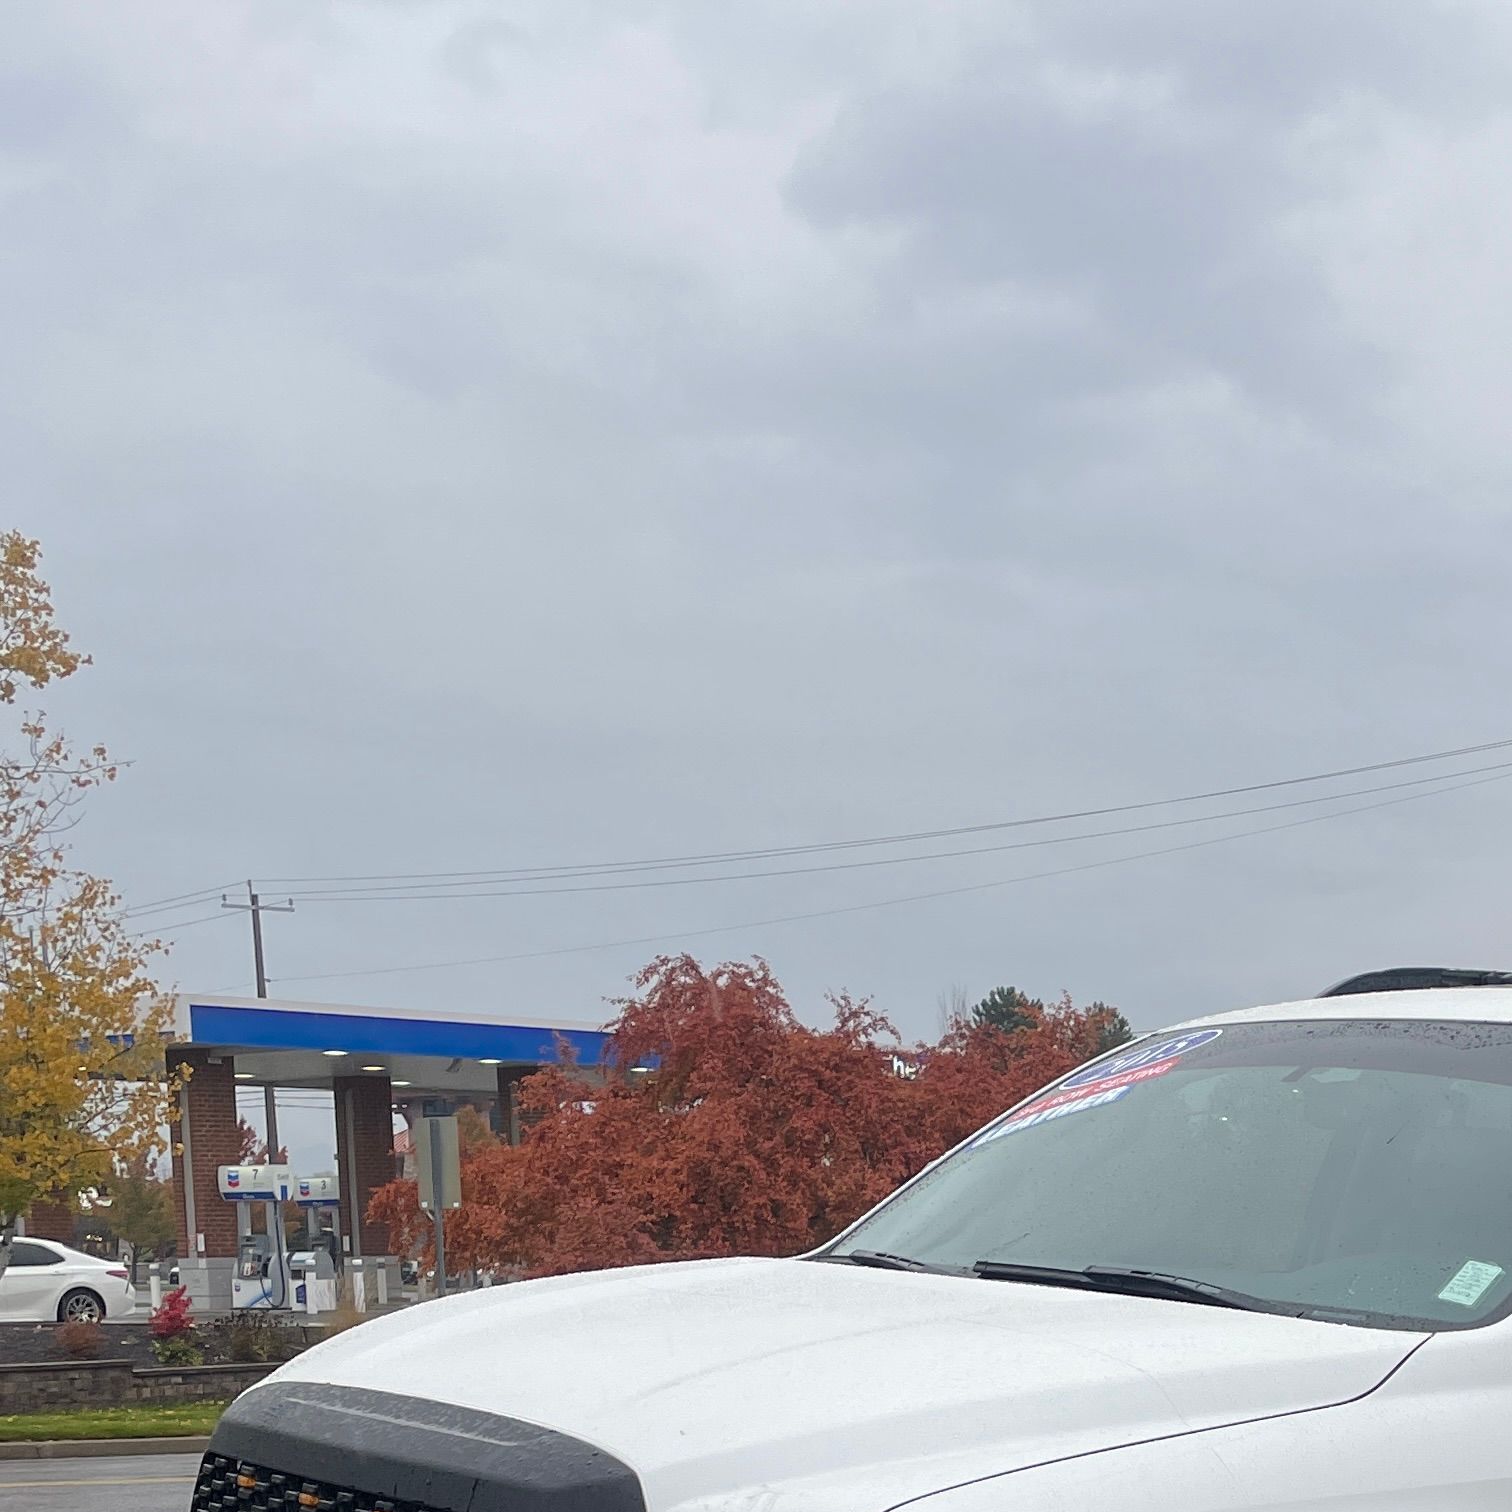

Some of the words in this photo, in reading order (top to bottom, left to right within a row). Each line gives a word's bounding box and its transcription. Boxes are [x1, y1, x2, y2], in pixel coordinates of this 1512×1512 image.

[1094, 1062, 1174, 1092] SEATING
[252, 1168, 259, 1181] 7
[320, 1179, 327, 1190] 3
